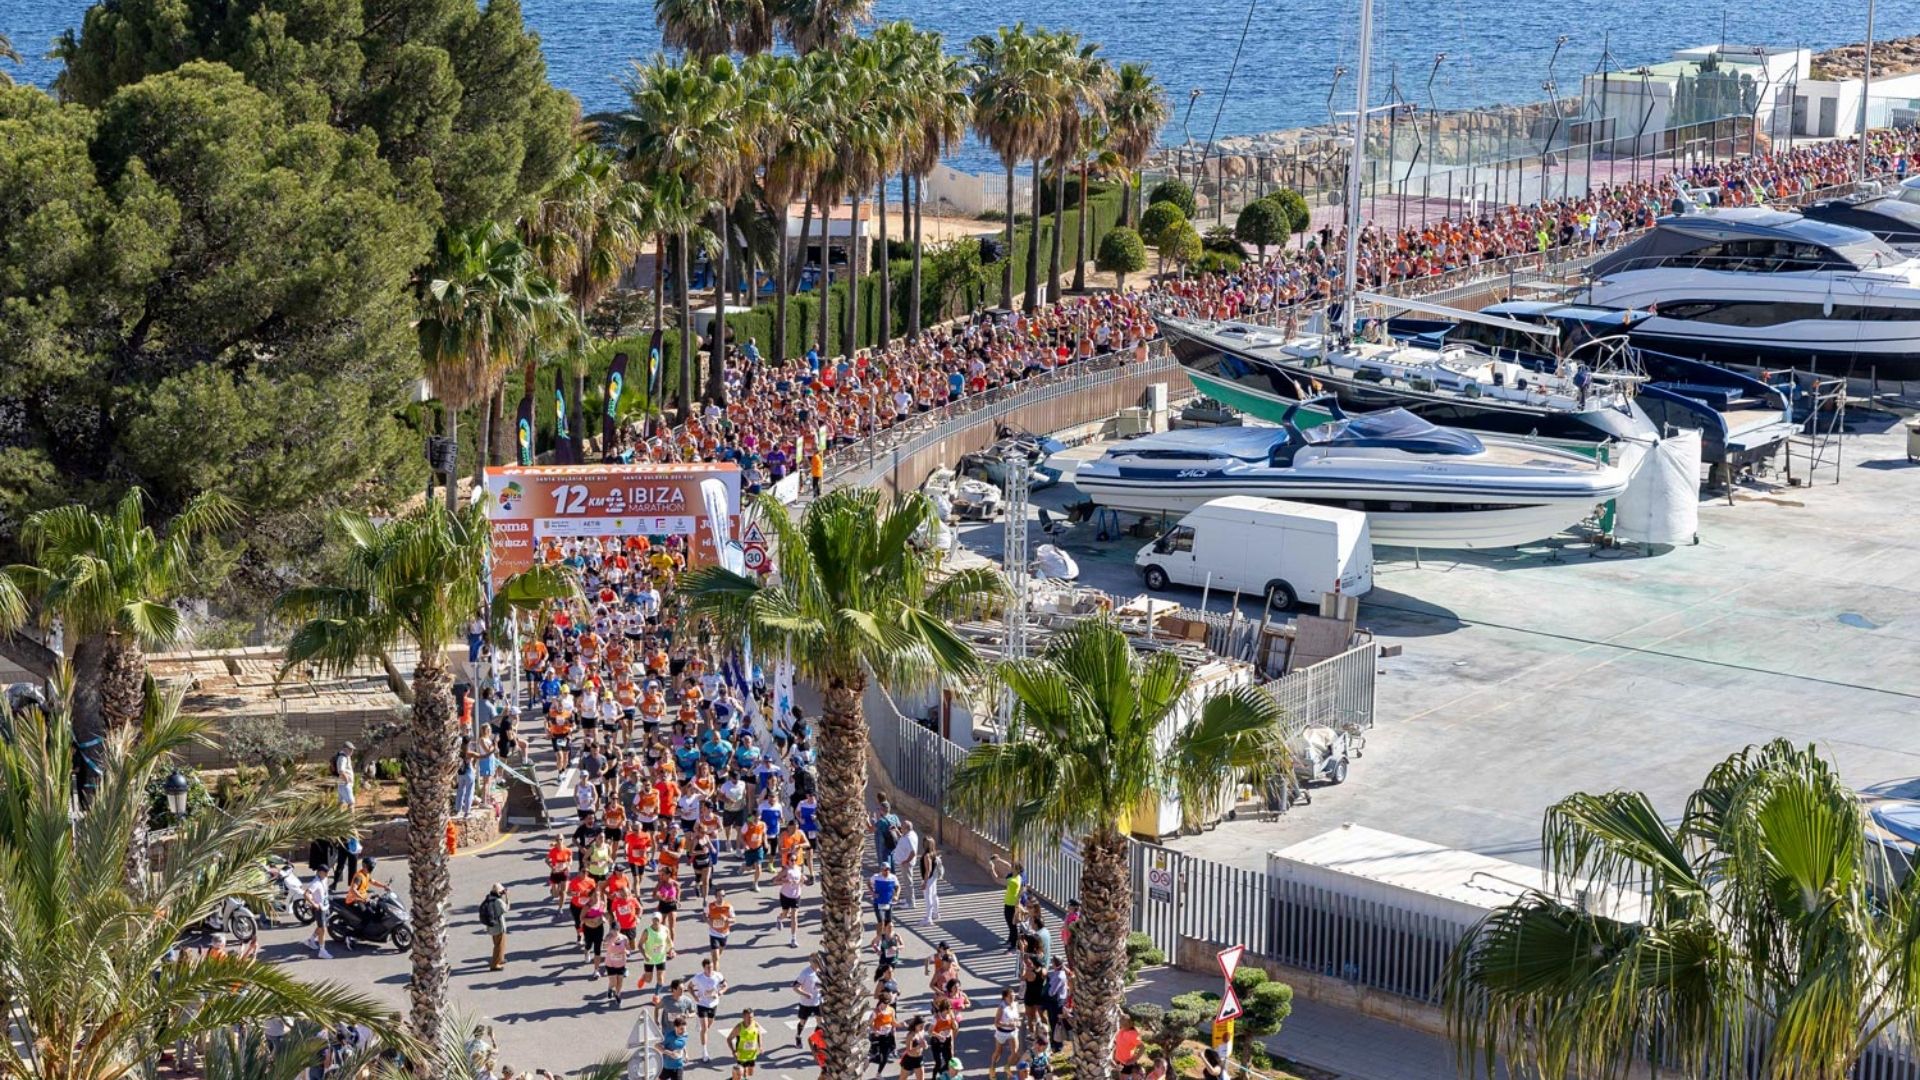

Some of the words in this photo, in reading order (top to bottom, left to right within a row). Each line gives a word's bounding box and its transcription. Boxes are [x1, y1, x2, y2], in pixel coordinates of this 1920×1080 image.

[551, 484, 589, 514] 12
[588, 497, 605, 507] KM
[629, 487, 685, 503] IBIZA
[628, 502, 685, 513] MARATHON
[747, 553, 761, 563] 30
